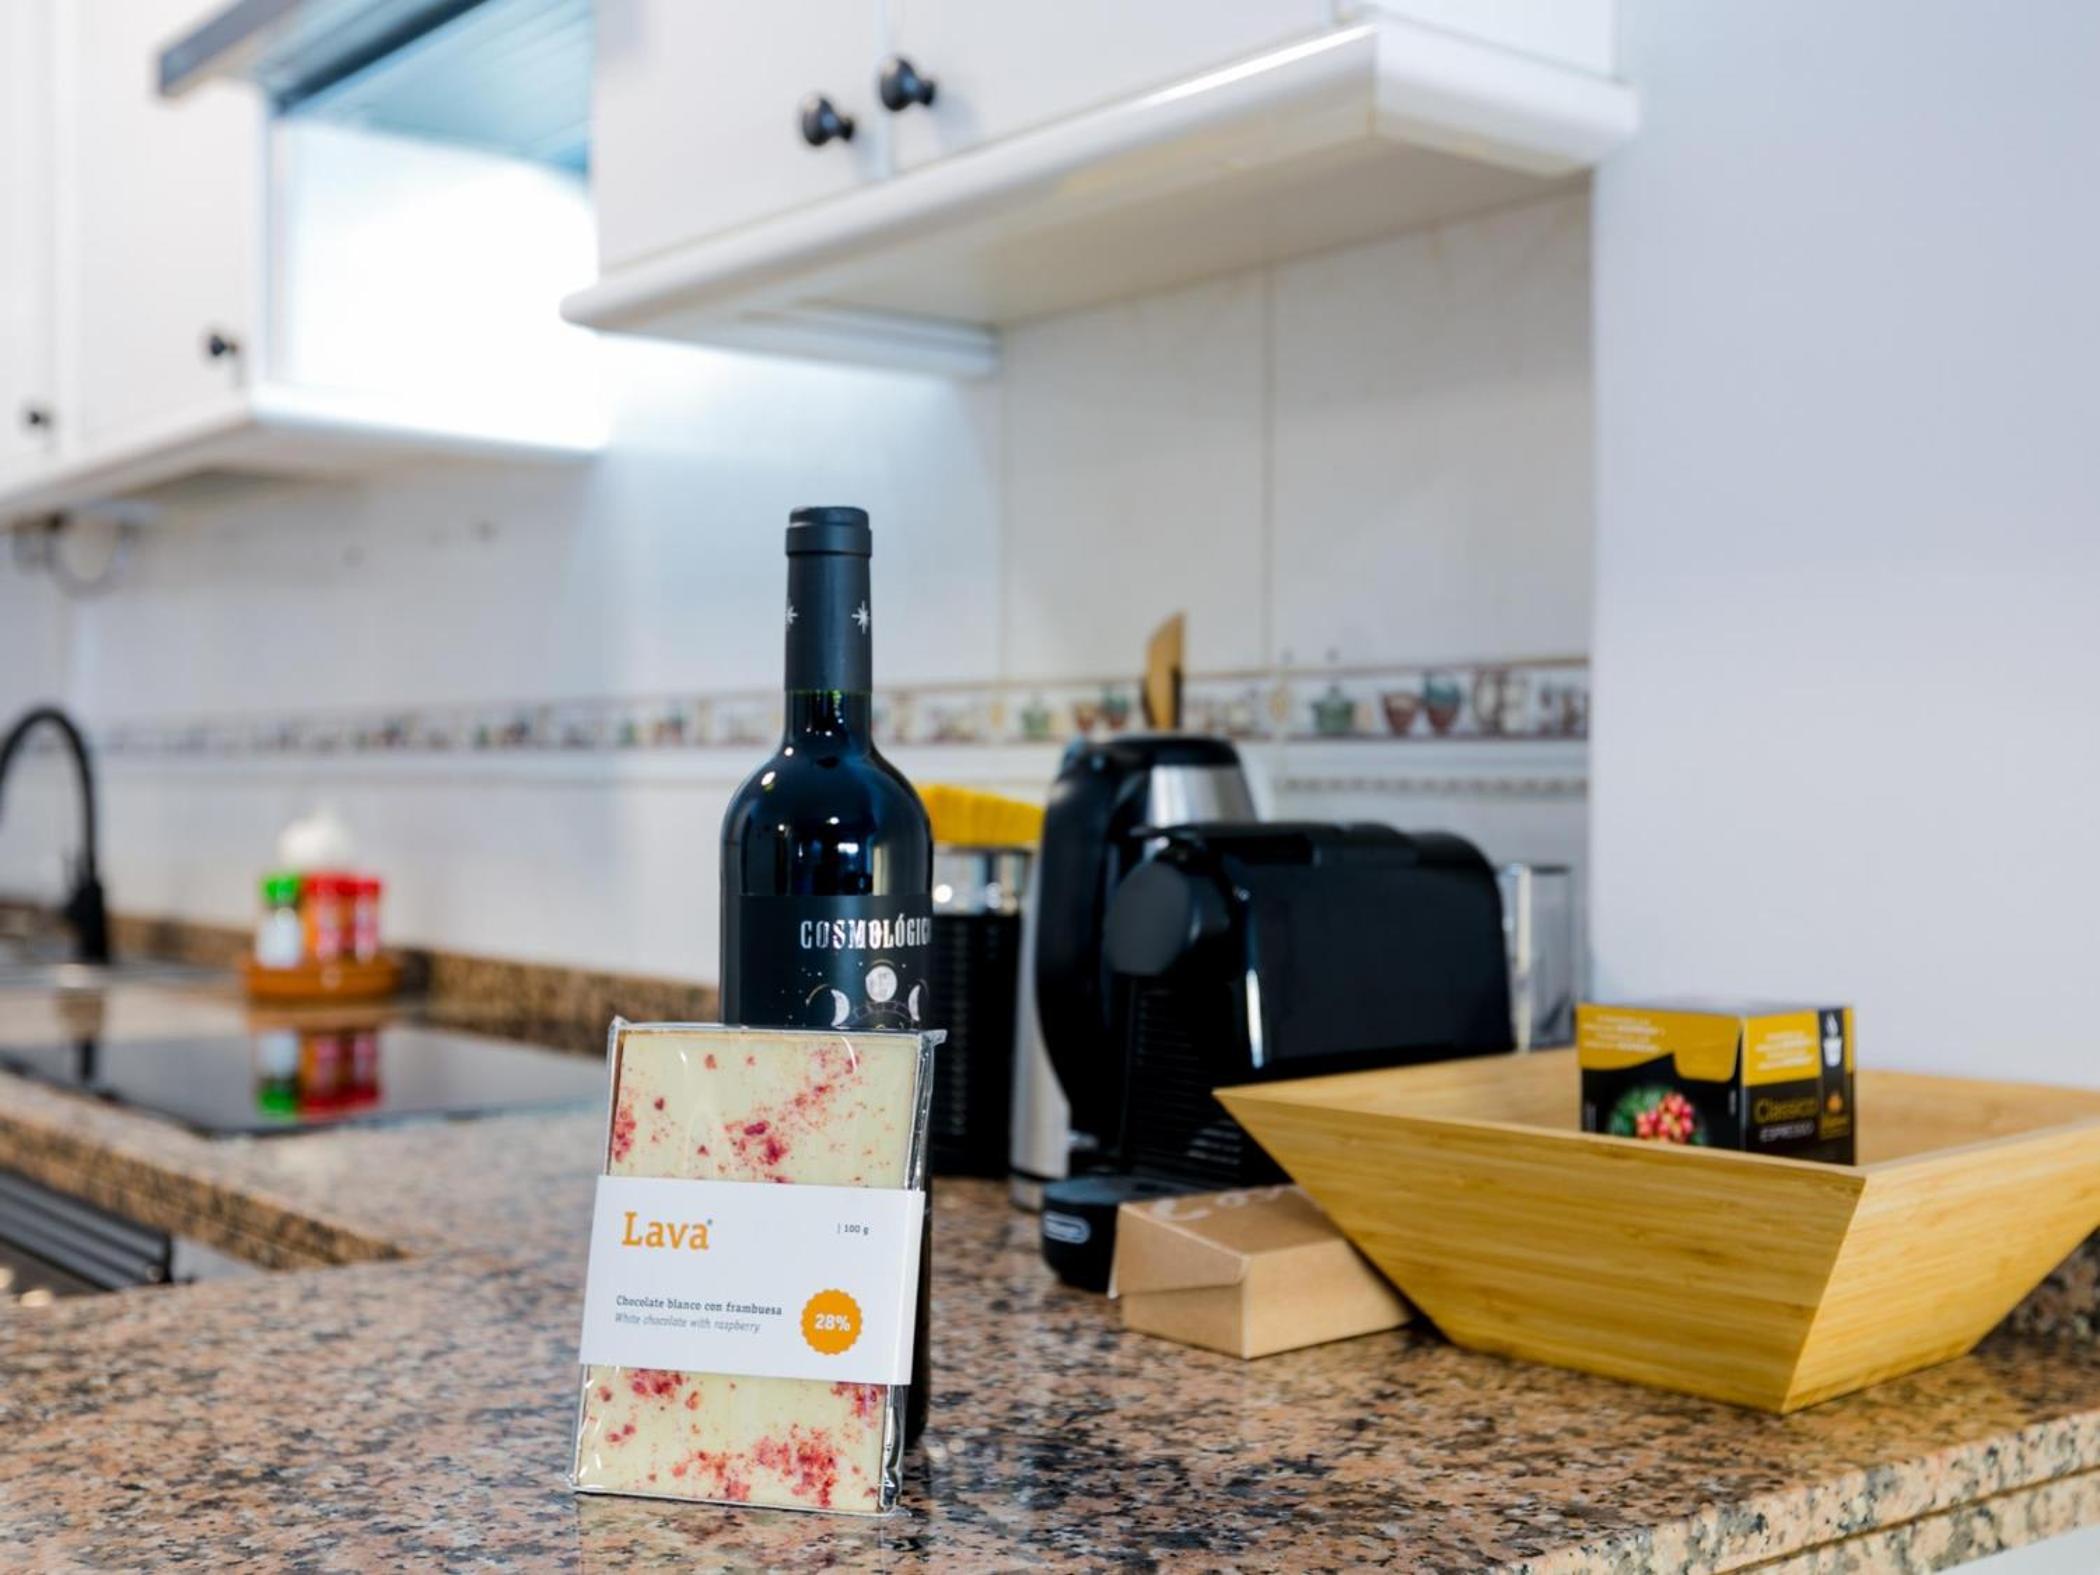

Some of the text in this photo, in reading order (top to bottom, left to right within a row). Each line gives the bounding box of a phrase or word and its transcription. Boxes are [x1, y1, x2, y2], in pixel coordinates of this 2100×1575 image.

[801, 913, 932, 949] COSMOLÓGIC
[621, 1211, 709, 1250] Lava
[844, 1224, 870, 1236] 100 g
[616, 1295, 782, 1315] Chocolate blanco con frambuesa
[615, 1312, 760, 1333] White chocolate with raspberry
[814, 1313, 850, 1331] 28%
